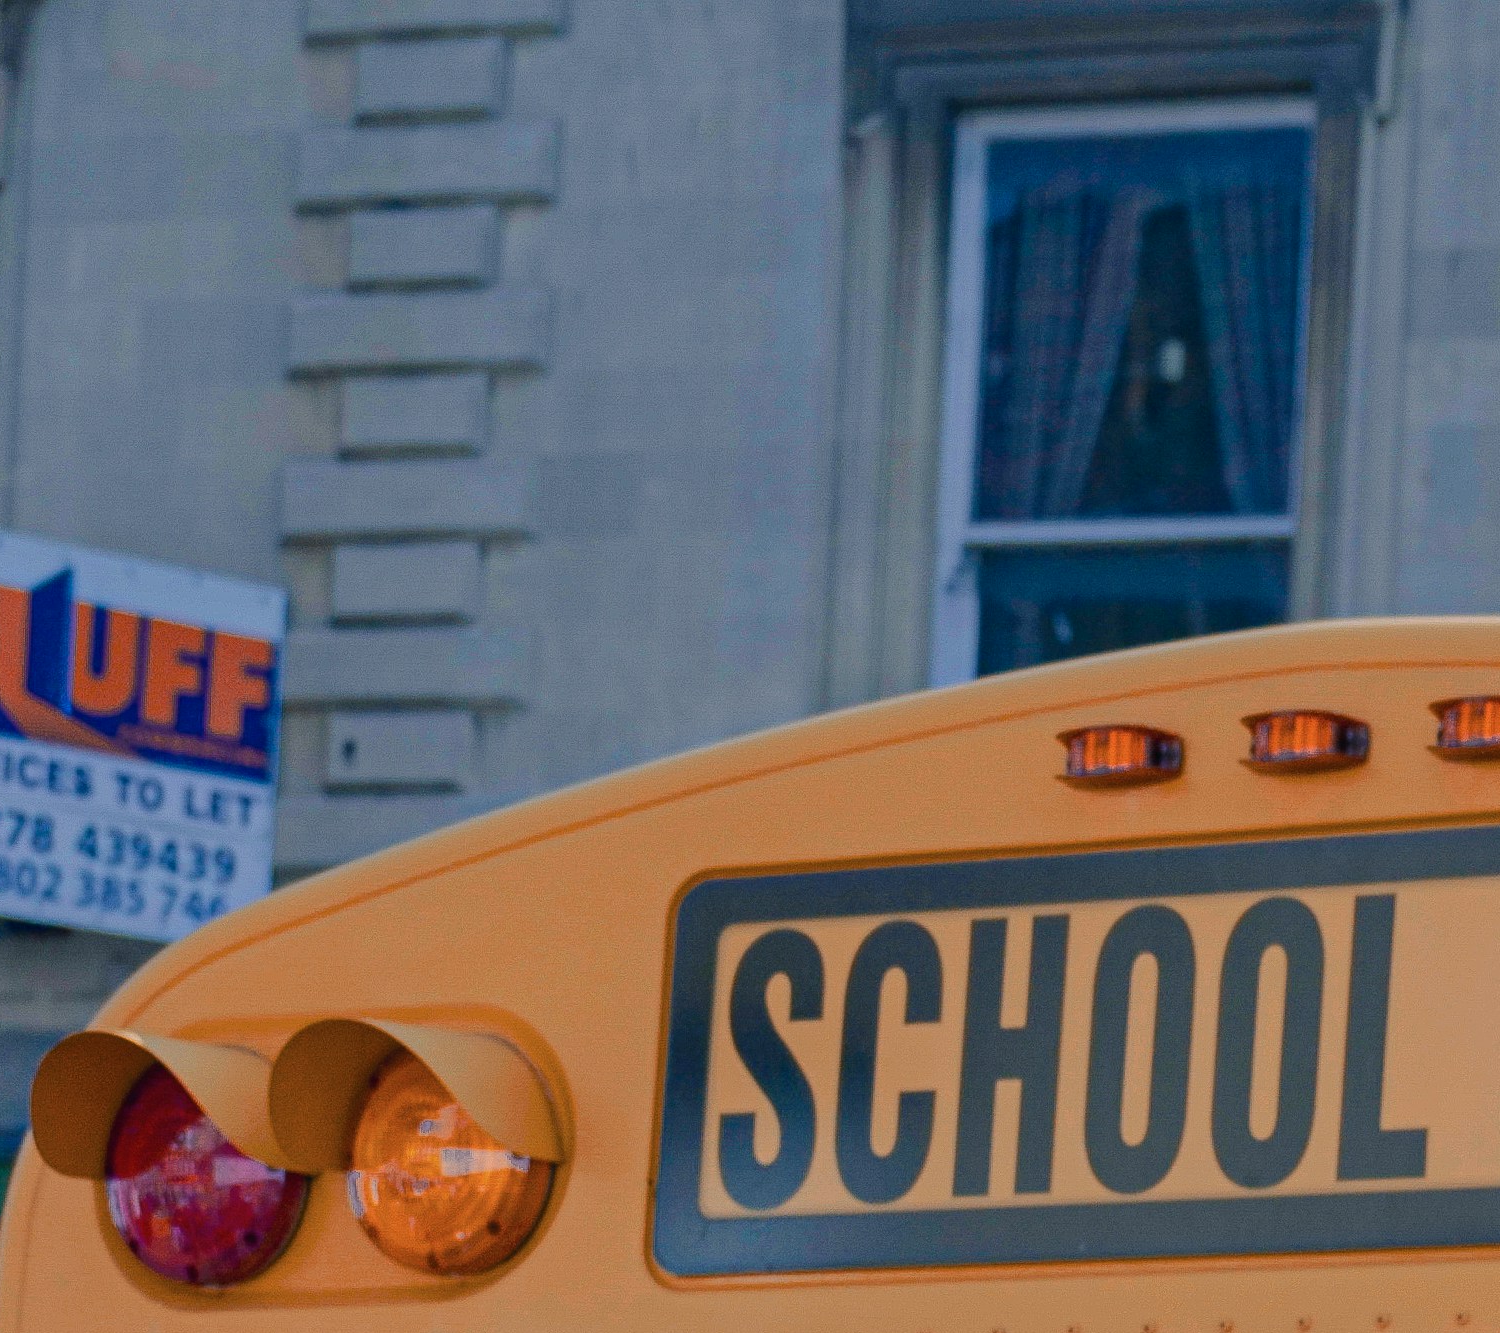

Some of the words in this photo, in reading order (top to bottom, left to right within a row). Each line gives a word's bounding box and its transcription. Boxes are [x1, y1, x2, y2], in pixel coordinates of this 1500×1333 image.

[115, 769, 166, 812] TO
[184, 784, 256, 827] LET
[77, 824, 237, 884] 439439
[716, 890, 1429, 1211] SCHOOL
